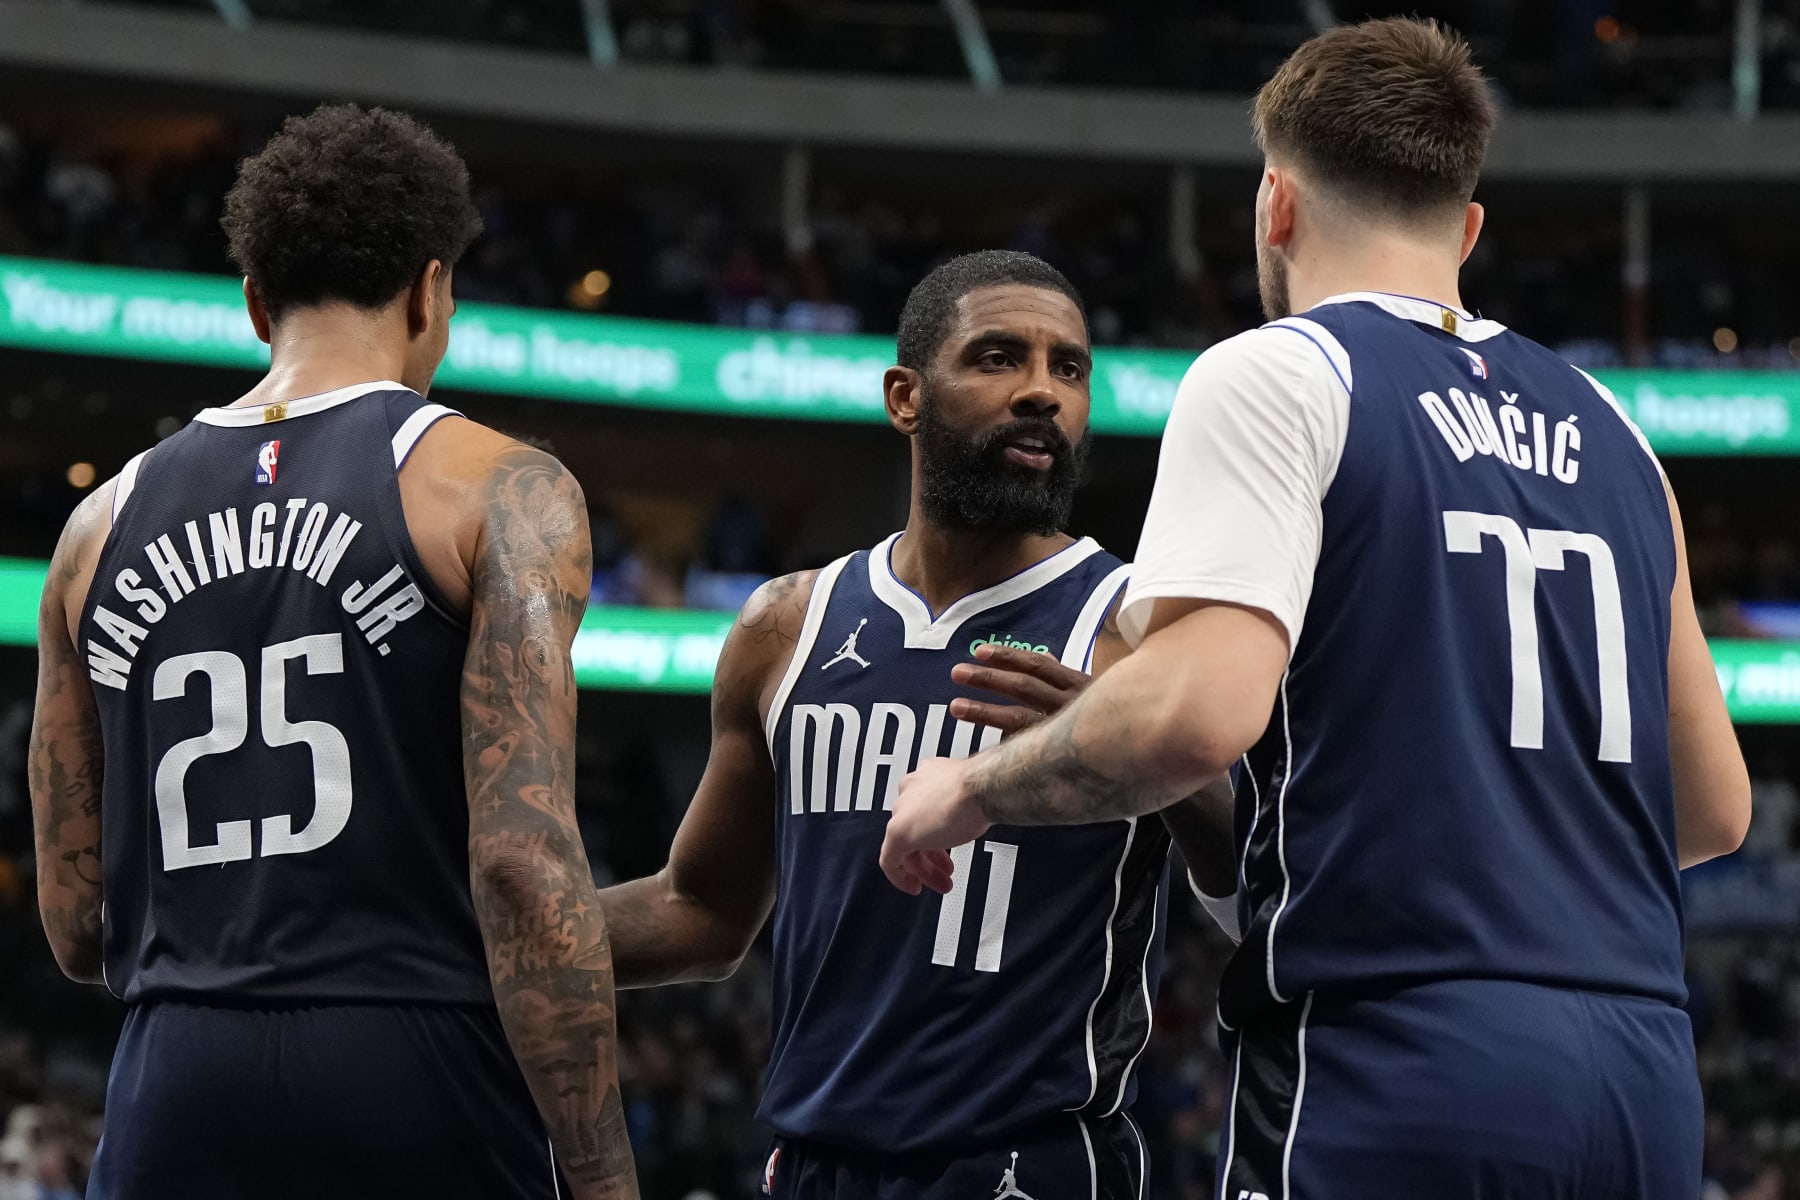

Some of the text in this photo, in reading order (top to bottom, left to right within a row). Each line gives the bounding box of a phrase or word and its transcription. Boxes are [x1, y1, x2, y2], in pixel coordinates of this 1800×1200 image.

[88, 498, 425, 690] WASHINGTON JR.
[1443, 511, 1632, 764] 77
[153, 633, 353, 872] 25
[932, 839, 1019, 972] 11
